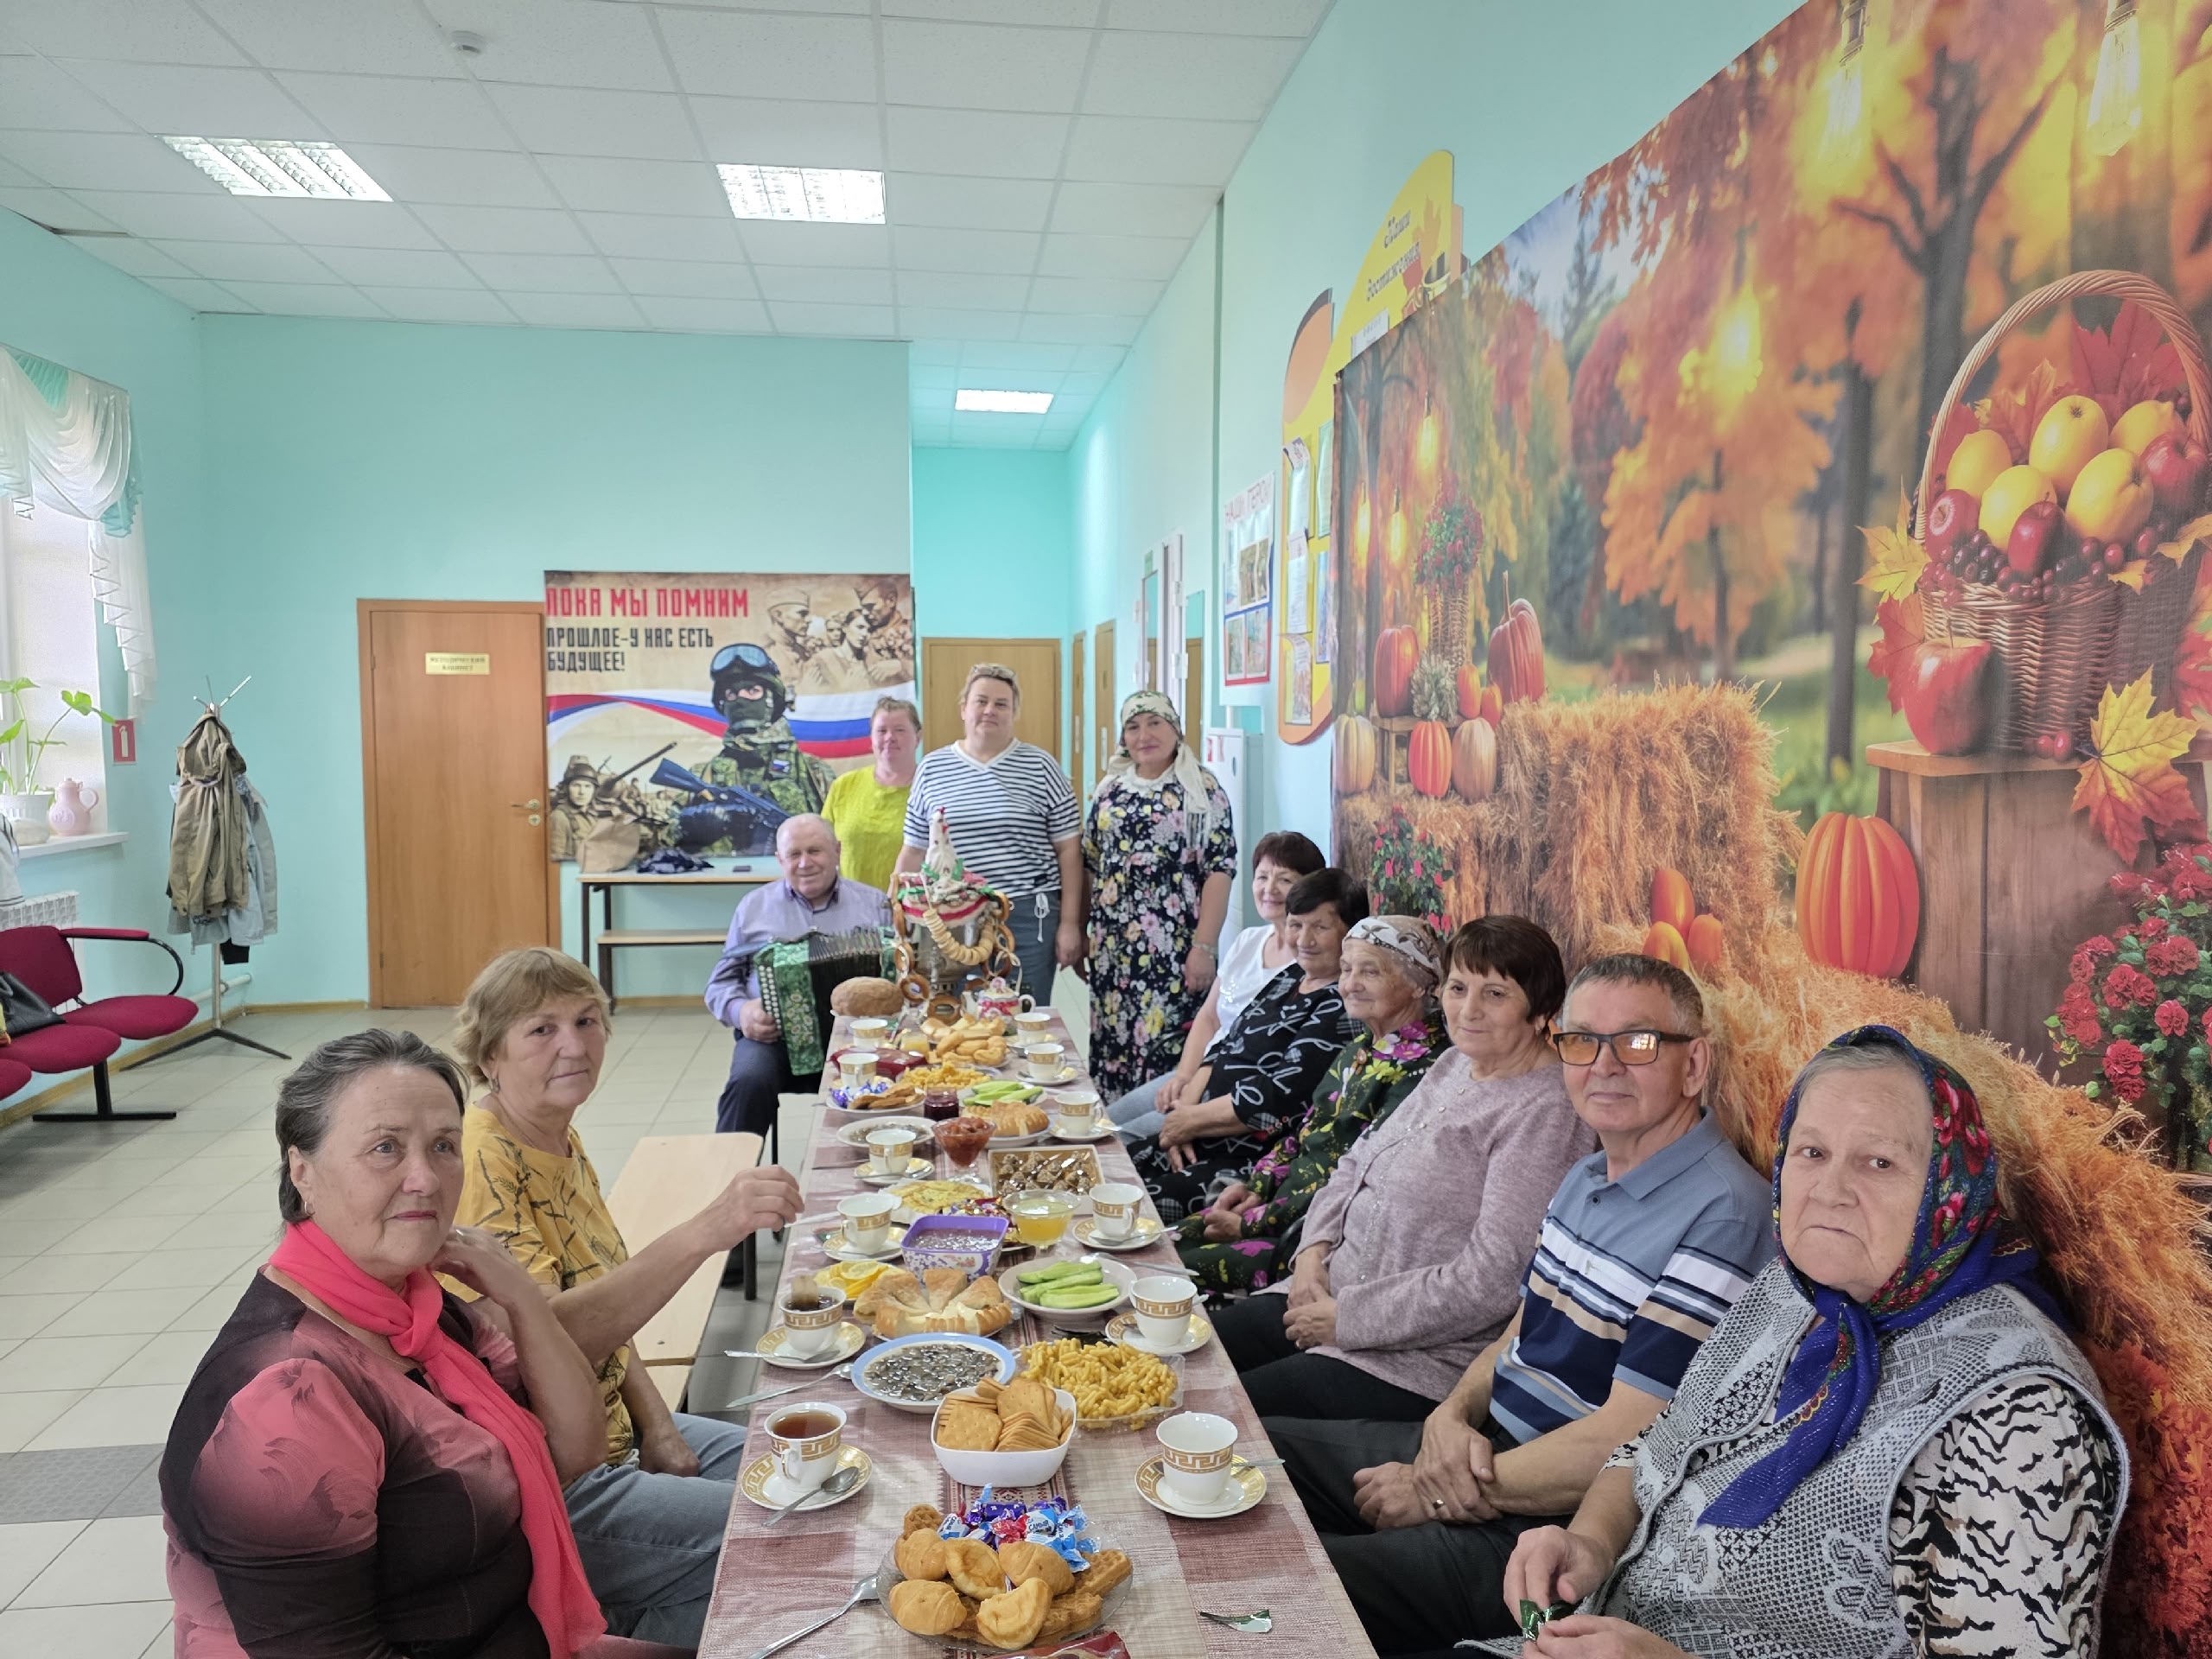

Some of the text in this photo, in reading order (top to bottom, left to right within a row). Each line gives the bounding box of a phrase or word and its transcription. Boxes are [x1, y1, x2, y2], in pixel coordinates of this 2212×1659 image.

[546, 588, 749, 617] ПОКА МЫ ПОМНИМ
[645, 628, 673, 647] НАС
[679, 629, 713, 647] ЕСТЬ
[547, 652, 625, 672] БУДУЩЕЕ!
